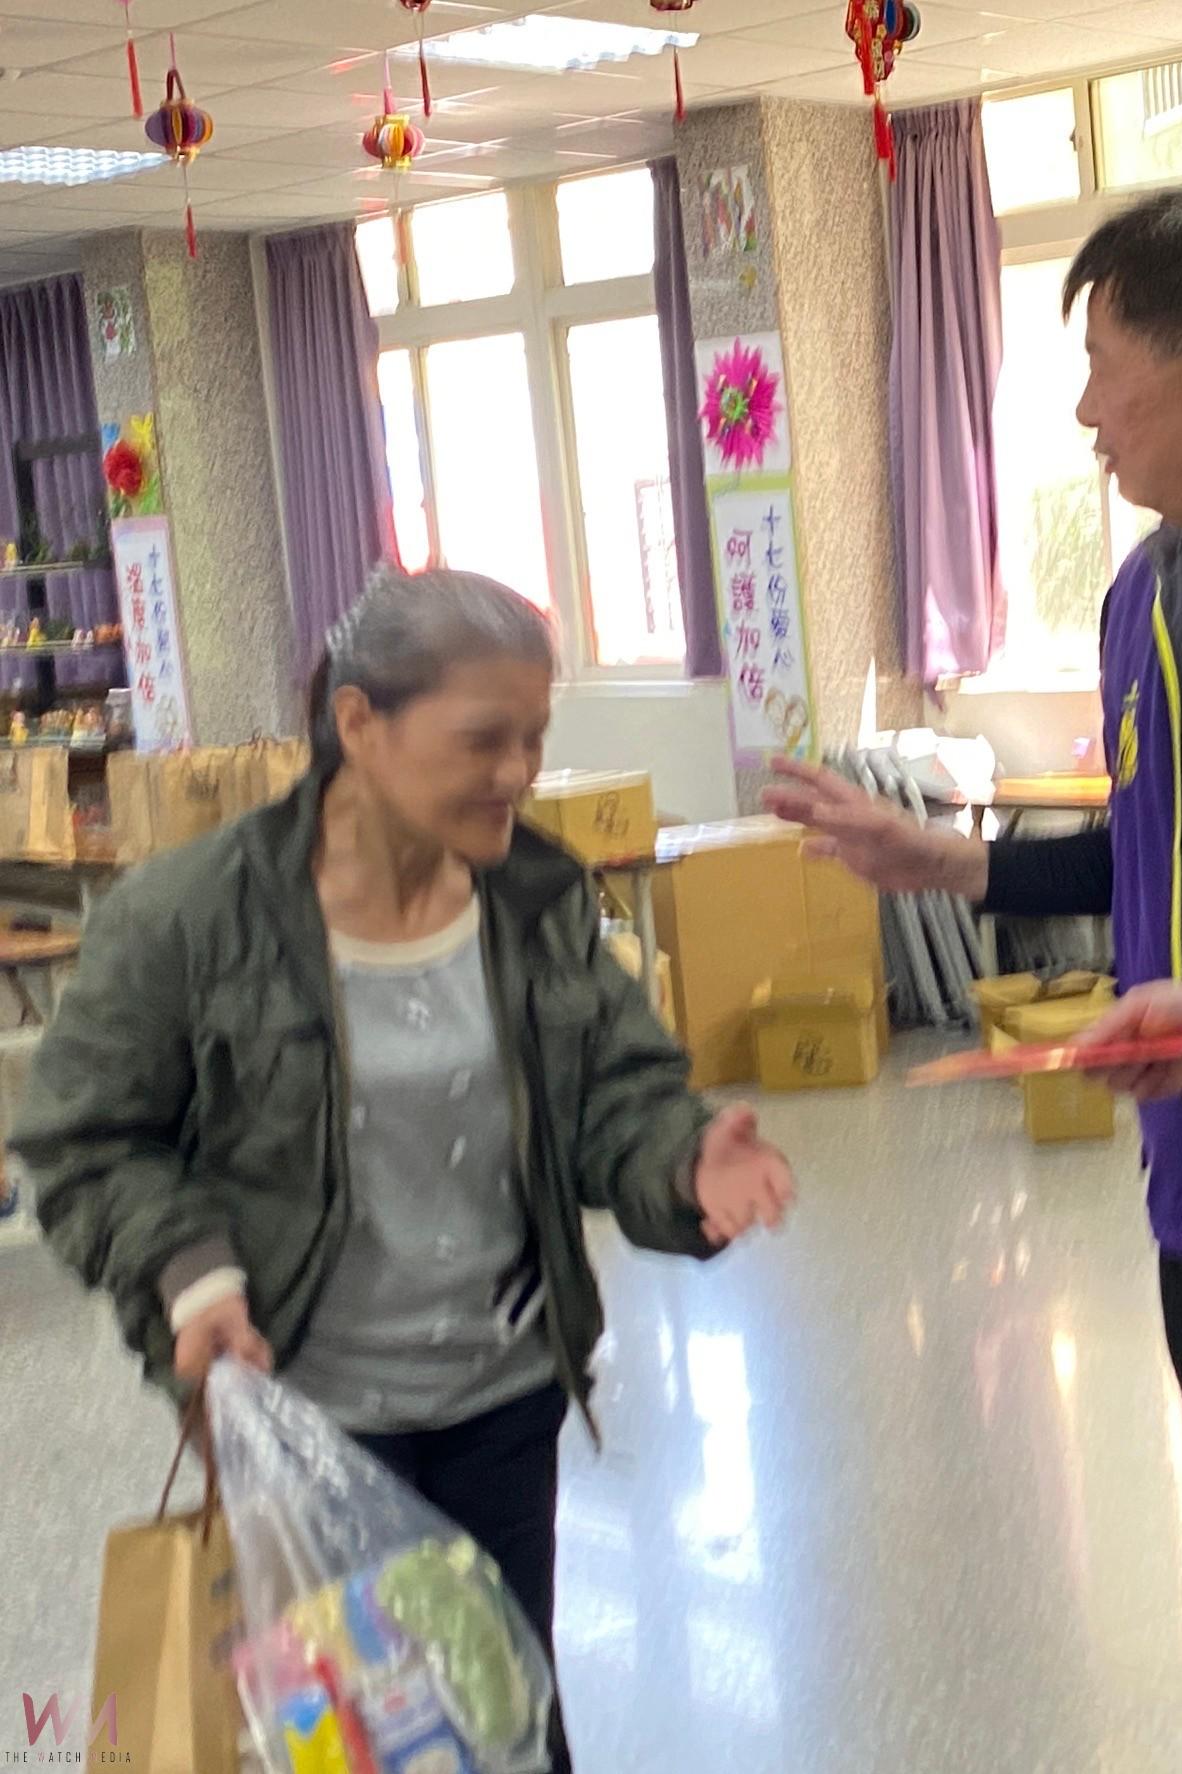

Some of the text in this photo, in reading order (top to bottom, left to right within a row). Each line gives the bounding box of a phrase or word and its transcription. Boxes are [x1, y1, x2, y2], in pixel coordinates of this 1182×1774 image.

[726, 528, 765, 706] 呵護加倍
[762, 504, 796, 674] 十七份愛心
